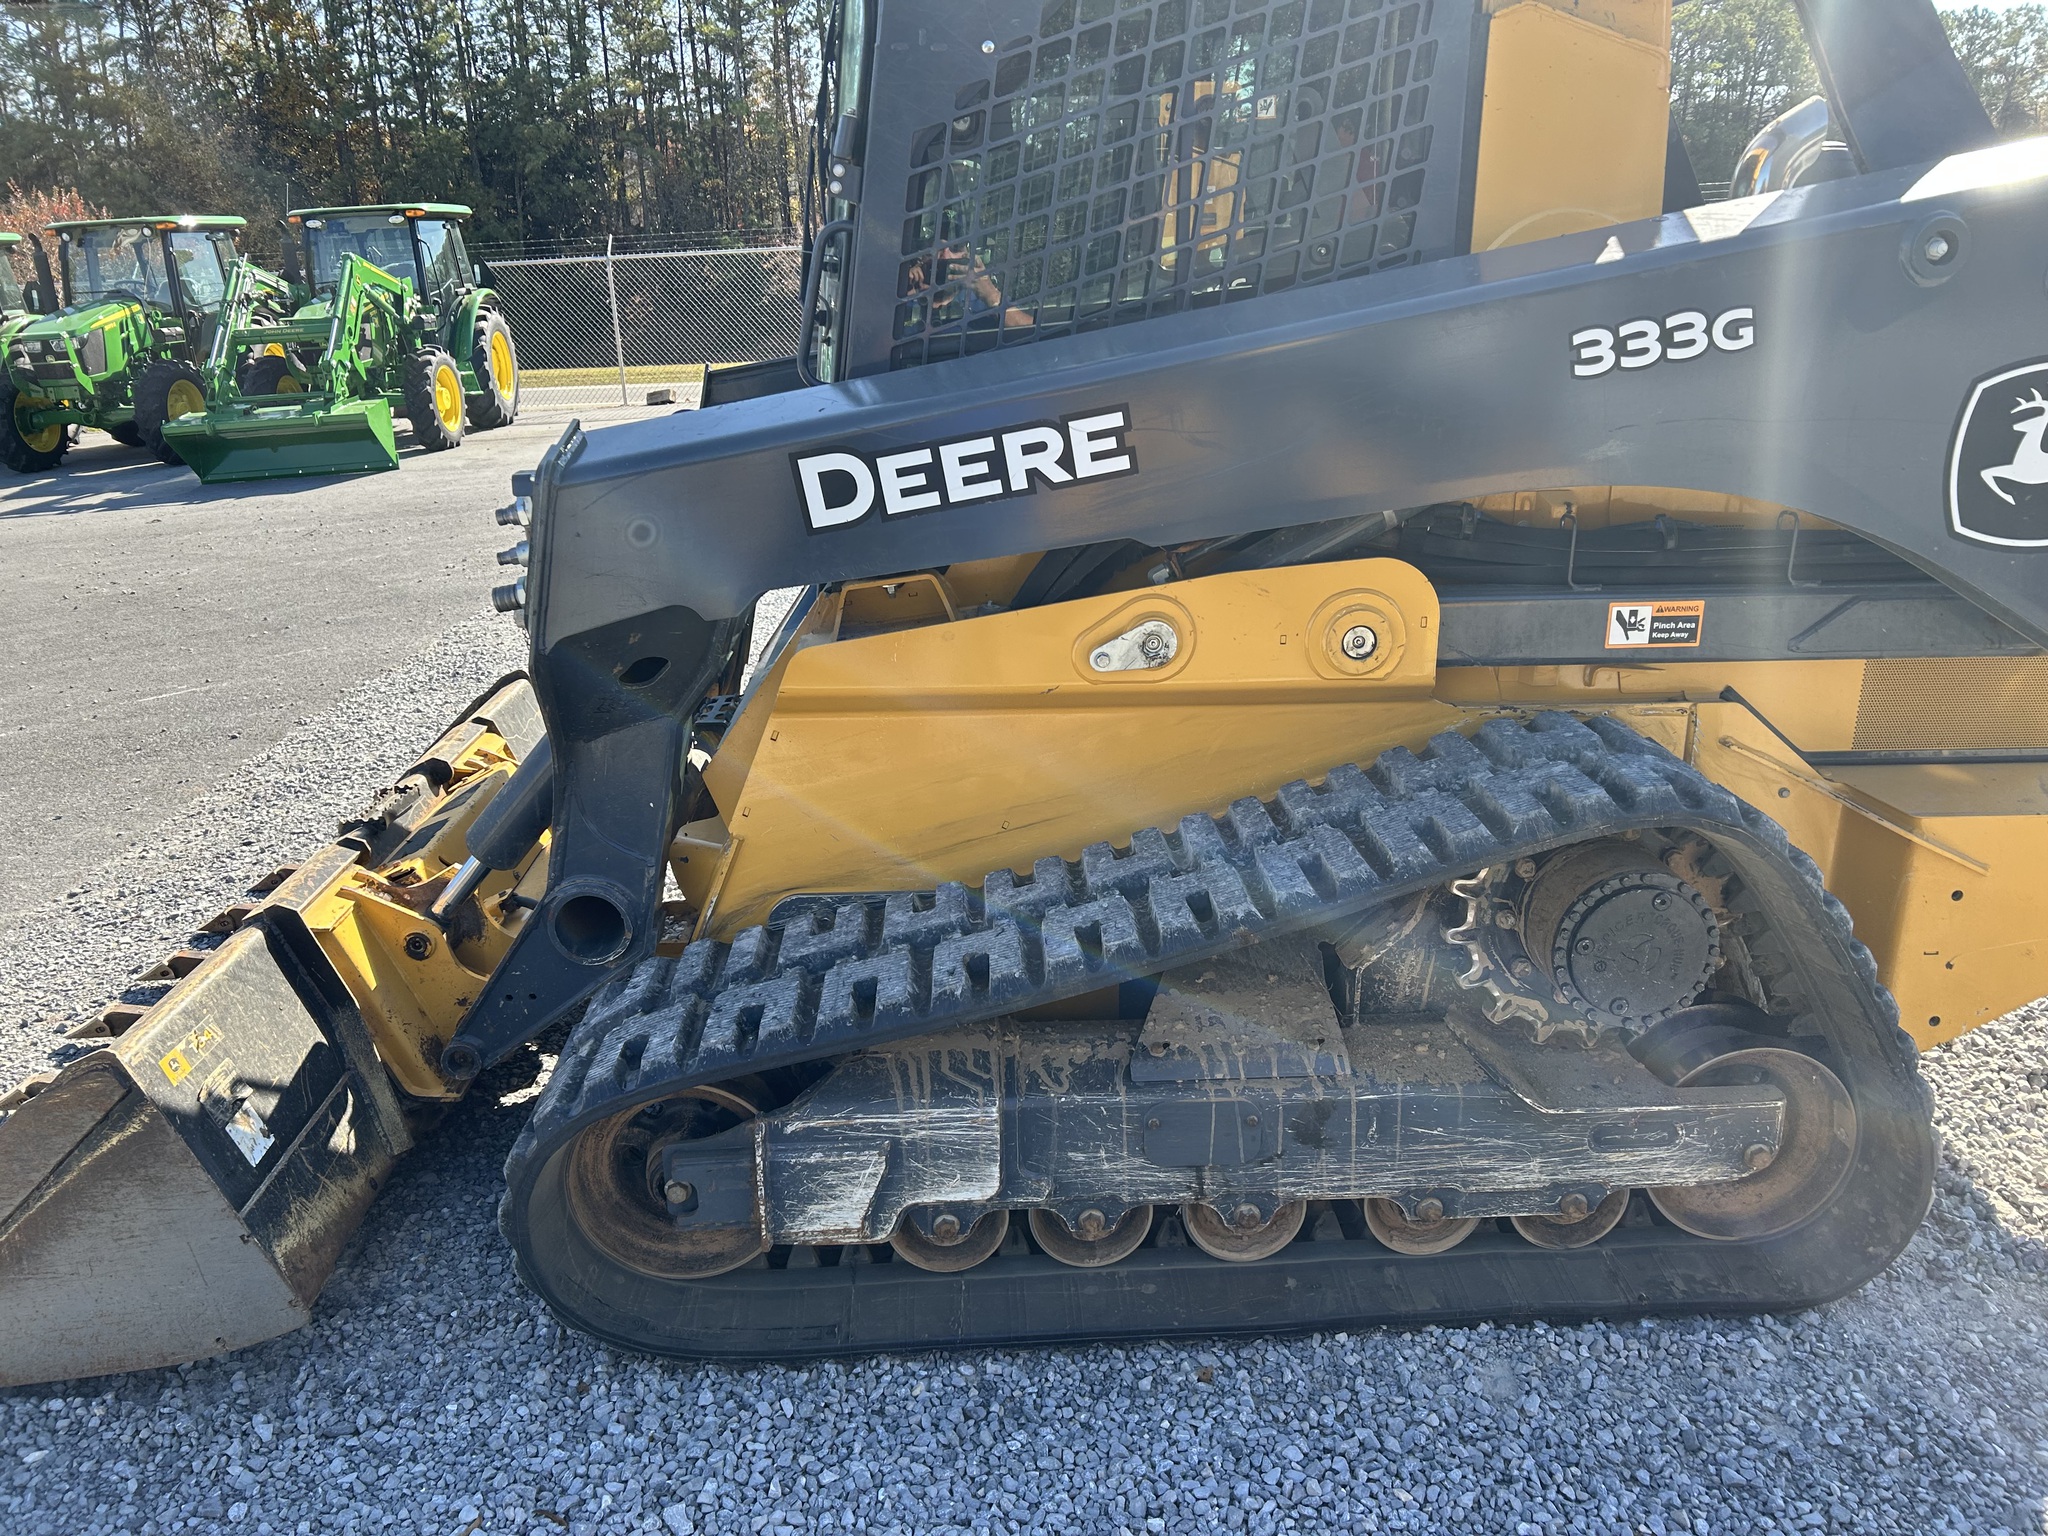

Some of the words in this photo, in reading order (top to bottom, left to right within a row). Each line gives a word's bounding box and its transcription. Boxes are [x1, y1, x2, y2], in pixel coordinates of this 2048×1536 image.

[1572, 308, 1754, 377] 333G
[797, 411, 1131, 528] DEERE
[1663, 605, 1699, 613] WARNING
[1677, 621, 1696, 629] Area
[1652, 631, 1670, 639] Keep
[1670, 631, 1689, 639] Away
